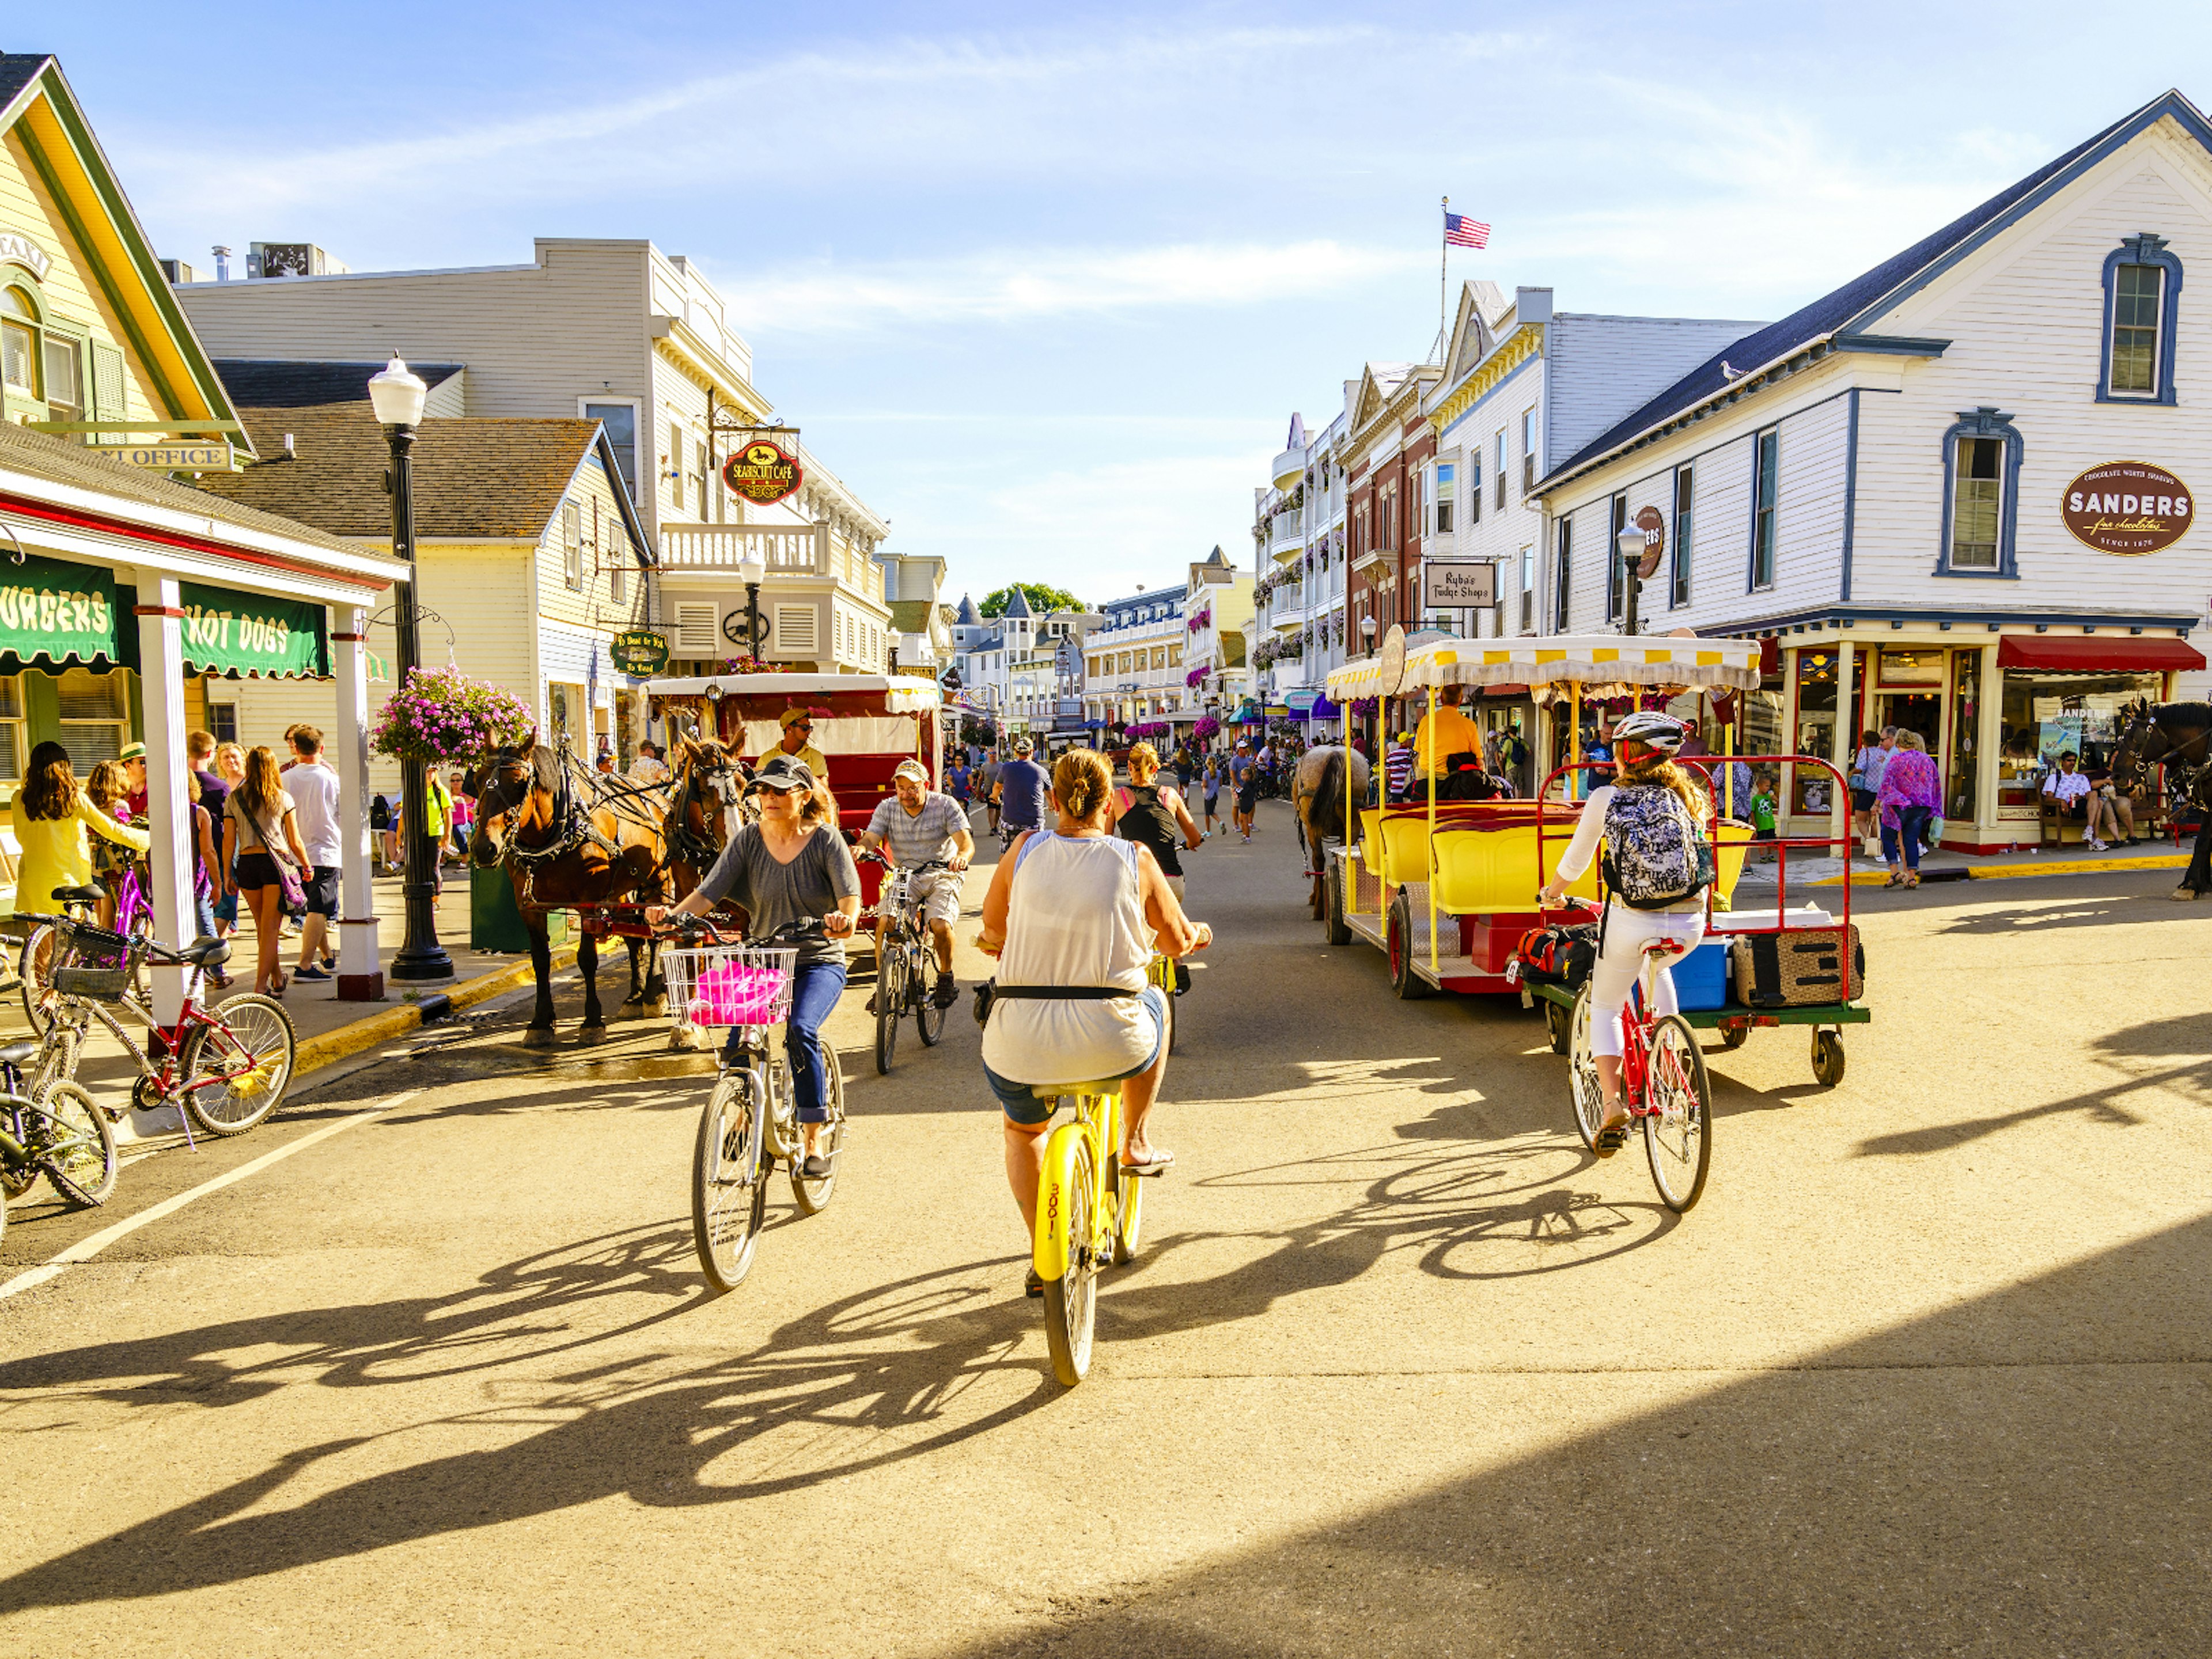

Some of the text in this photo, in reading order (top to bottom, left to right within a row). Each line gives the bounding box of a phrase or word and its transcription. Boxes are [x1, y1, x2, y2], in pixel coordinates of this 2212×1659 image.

[132, 449, 222, 464] OFFICE
[733, 464, 793, 479] SEABISCUIT CAFÉ
[2084, 469, 2121, 482] CHOCOLATE
[2069, 491, 2188, 517] SANDERS
[2101, 537, 2128, 547] SINCE
[1445, 571, 1475, 588] Ryba's
[1431, 585, 1488, 600] Fudge Shops
[185, 605, 289, 656] HOT DOGS
